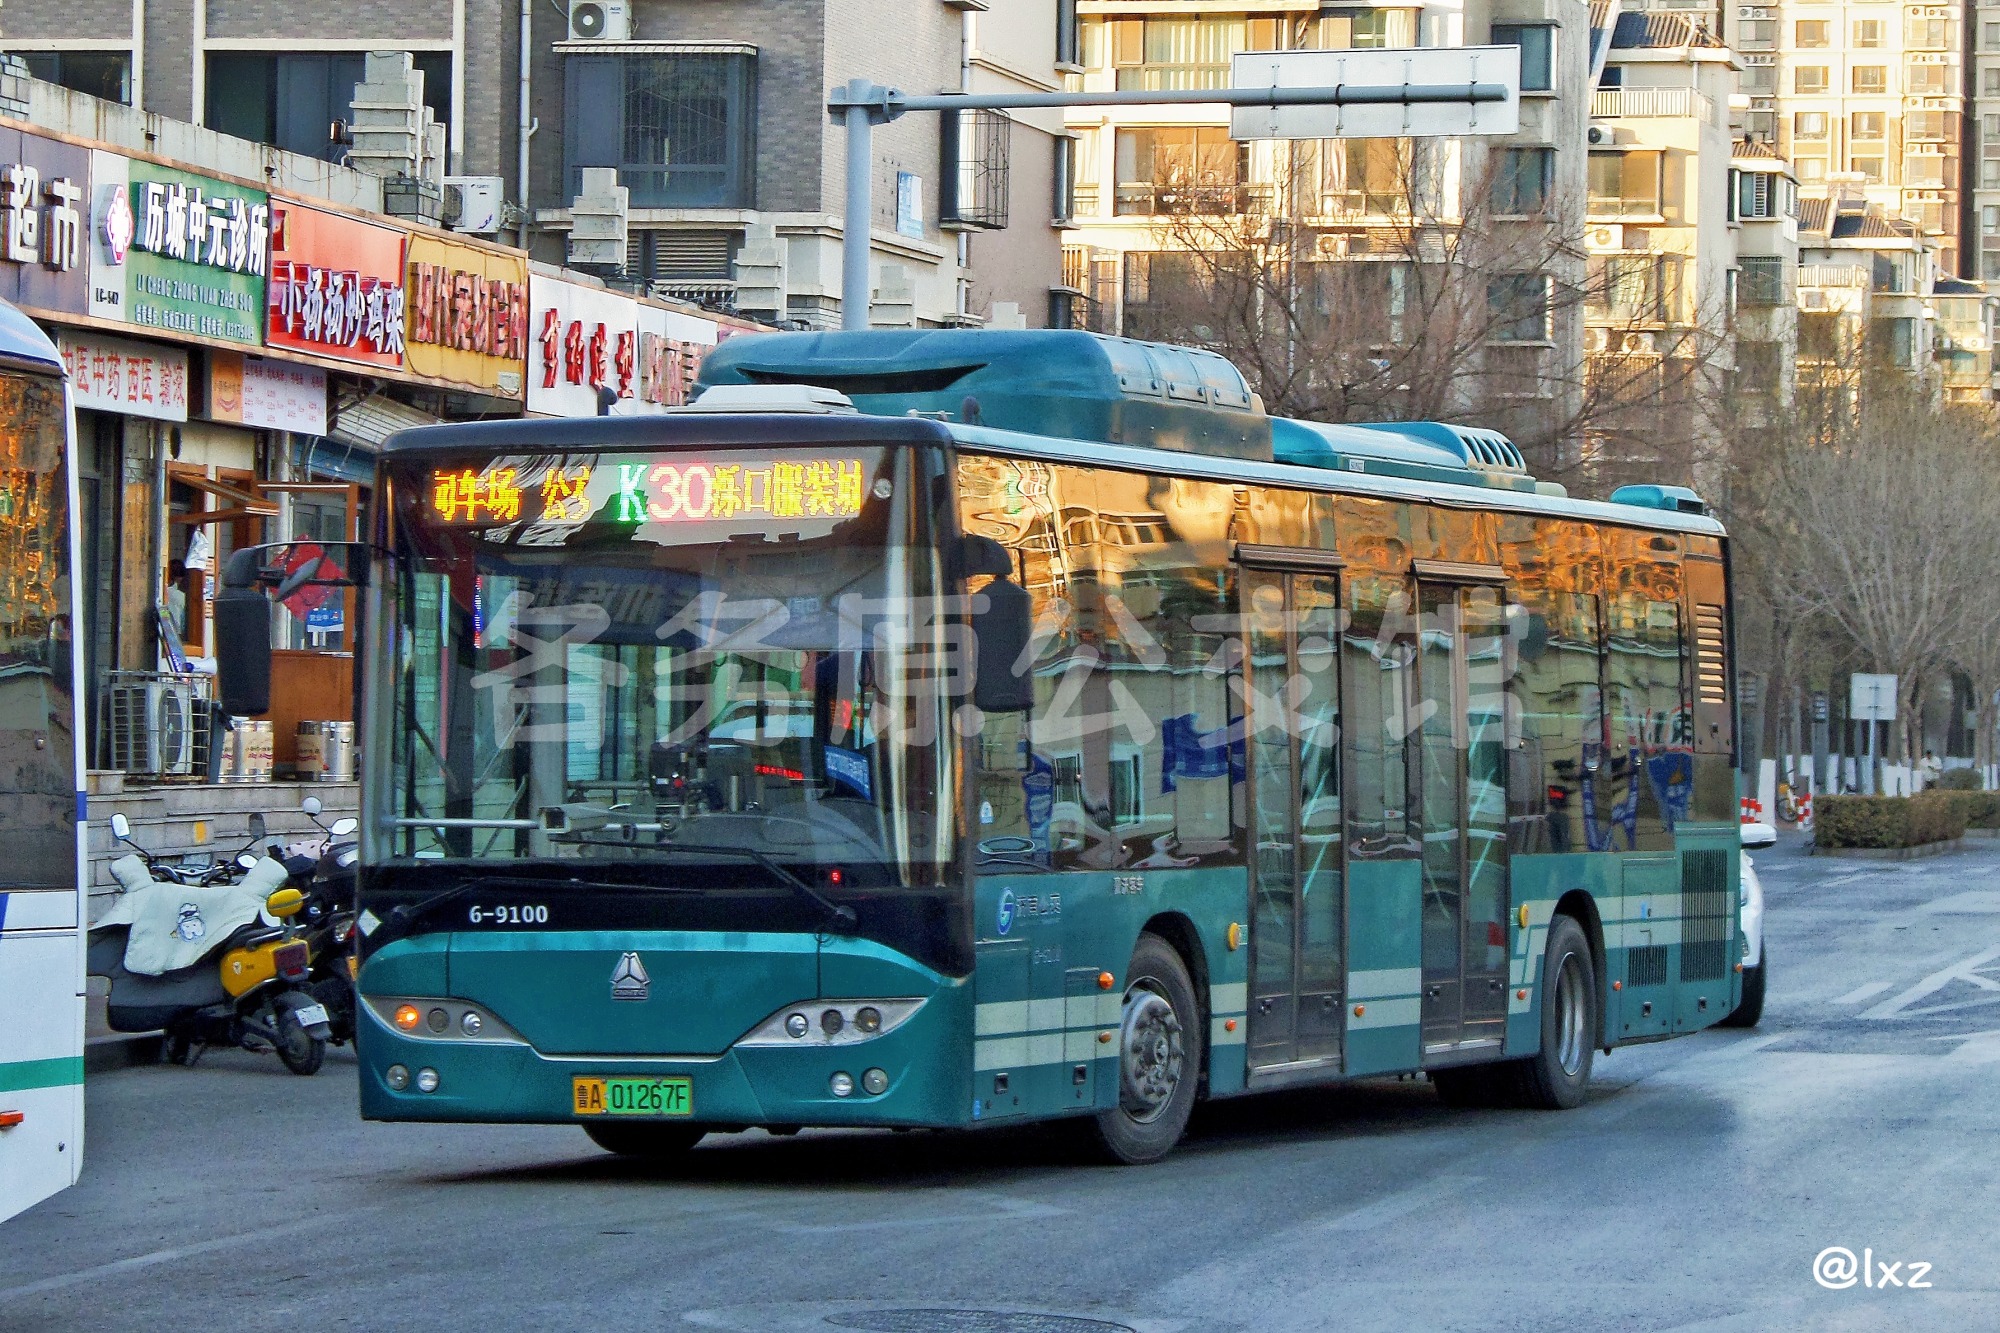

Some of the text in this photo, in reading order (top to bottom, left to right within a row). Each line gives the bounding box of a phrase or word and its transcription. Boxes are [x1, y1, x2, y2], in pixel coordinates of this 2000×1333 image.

[8, 163, 82, 272] 超市
[145, 181, 268, 277] 历城中元诊所
[616, 463, 711, 522] K30
[469, 905, 548, 924] 6-9100
